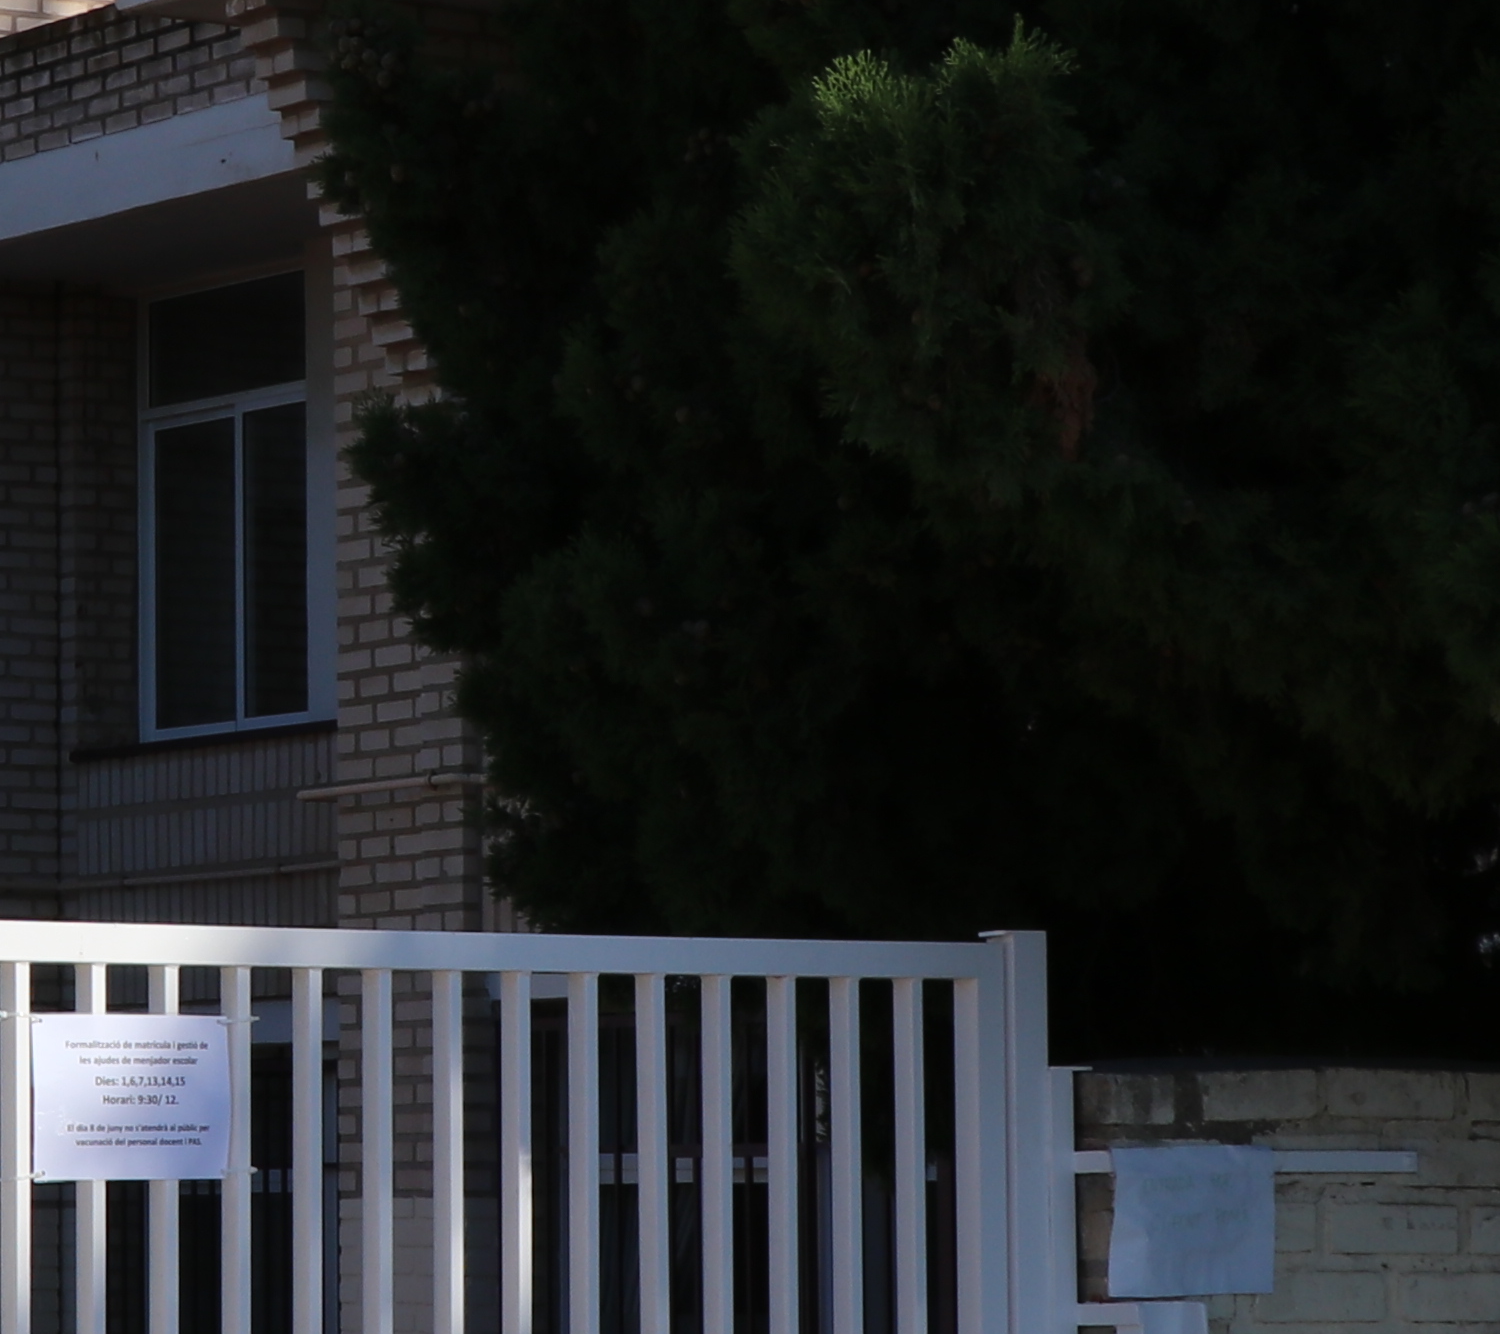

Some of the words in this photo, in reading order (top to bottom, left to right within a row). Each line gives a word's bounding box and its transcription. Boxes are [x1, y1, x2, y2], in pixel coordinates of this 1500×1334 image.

[123, 1040, 132, 1049] de
[199, 1041, 208, 1050] de
[79, 1055, 91, 1065] les
[93, 1055, 120, 1066] ajudes
[121, 1055, 131, 1065] de
[133, 1055, 170, 1066] menjador
[172, 1056, 198, 1065] escolar
[95, 1076, 119, 1086] Dies:
[121, 1076, 186, 1087] 1,6,7,13,14,15
[103, 1094, 136, 1105] Horari:
[137, 1094, 163, 1106] 9:30/
[165, 1095, 179, 1105] 12.
[76, 1124, 88, 1132] dia
[96, 1124, 106, 1132] de
[115, 1138, 126, 1146] del
[127, 1138, 158, 1147] personal
[159, 1138, 183, 1146] docent
